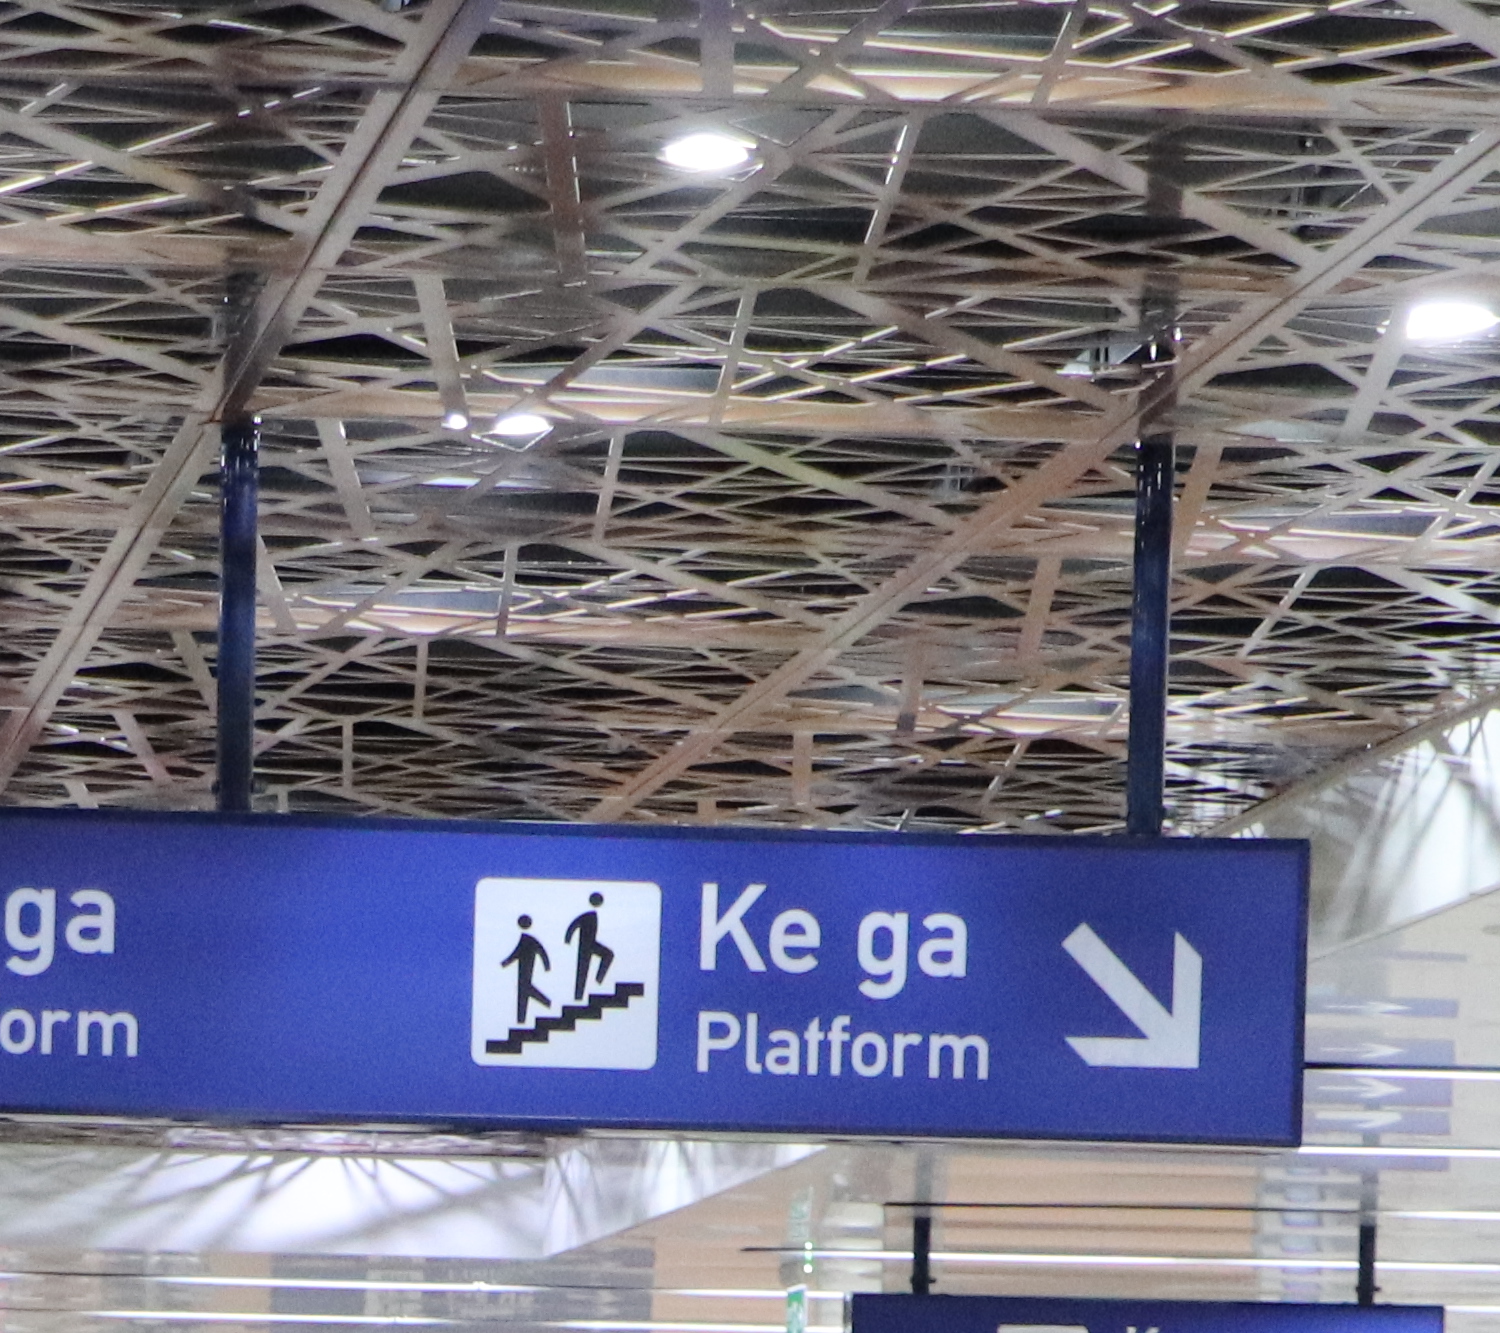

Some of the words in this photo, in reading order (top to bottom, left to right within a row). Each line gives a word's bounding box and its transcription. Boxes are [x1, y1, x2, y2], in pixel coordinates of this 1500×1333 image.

[4, 887, 115, 976] ga
[699, 883, 821, 972] Ke
[858, 911, 967, 1000] ga
[696, 1011, 989, 1080] Platform
